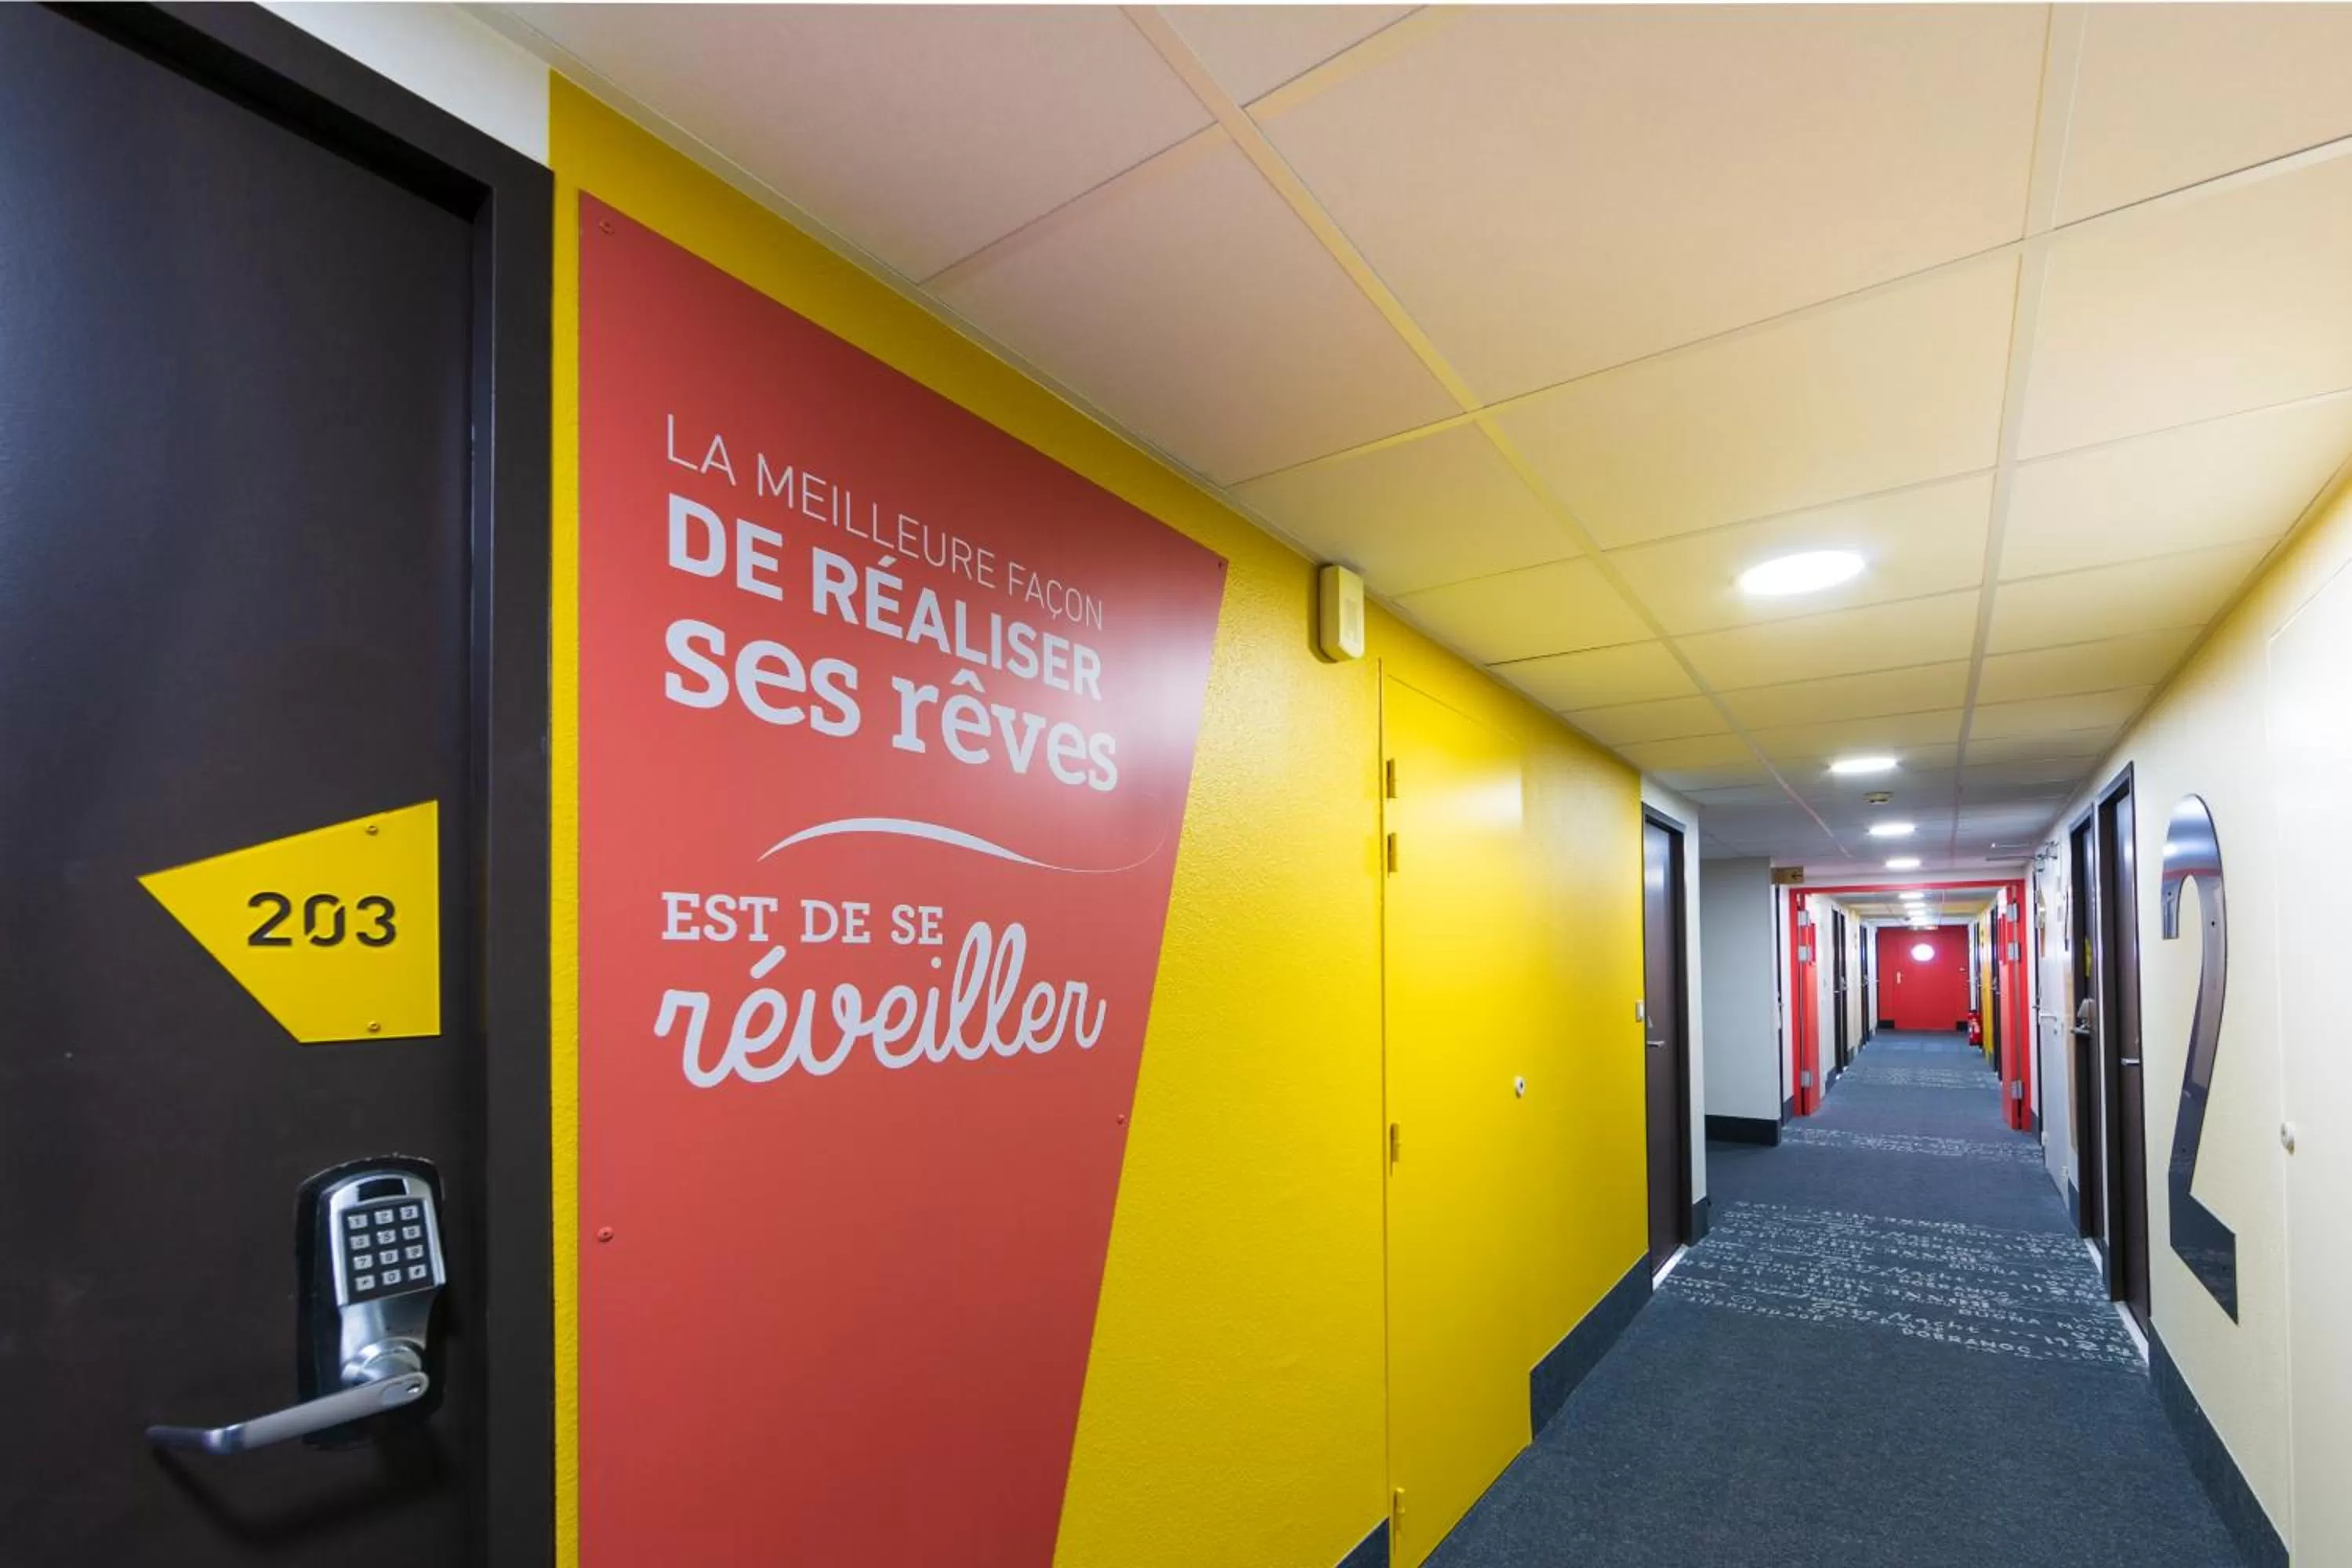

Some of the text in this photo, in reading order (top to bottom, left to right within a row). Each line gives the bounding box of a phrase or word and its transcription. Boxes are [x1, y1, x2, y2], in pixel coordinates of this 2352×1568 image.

[666, 413, 1103, 631] LA MEILLEURE FAÇON
[668, 492, 1103, 702] DE RÉALISER
[664, 618, 1118, 793] ses rêves
[246, 891, 397, 948] 203
[654, 920, 1107, 1089] réveiller
[661, 891, 944, 946] EST DE SE
[2161, 793, 2239, 1325] 2
